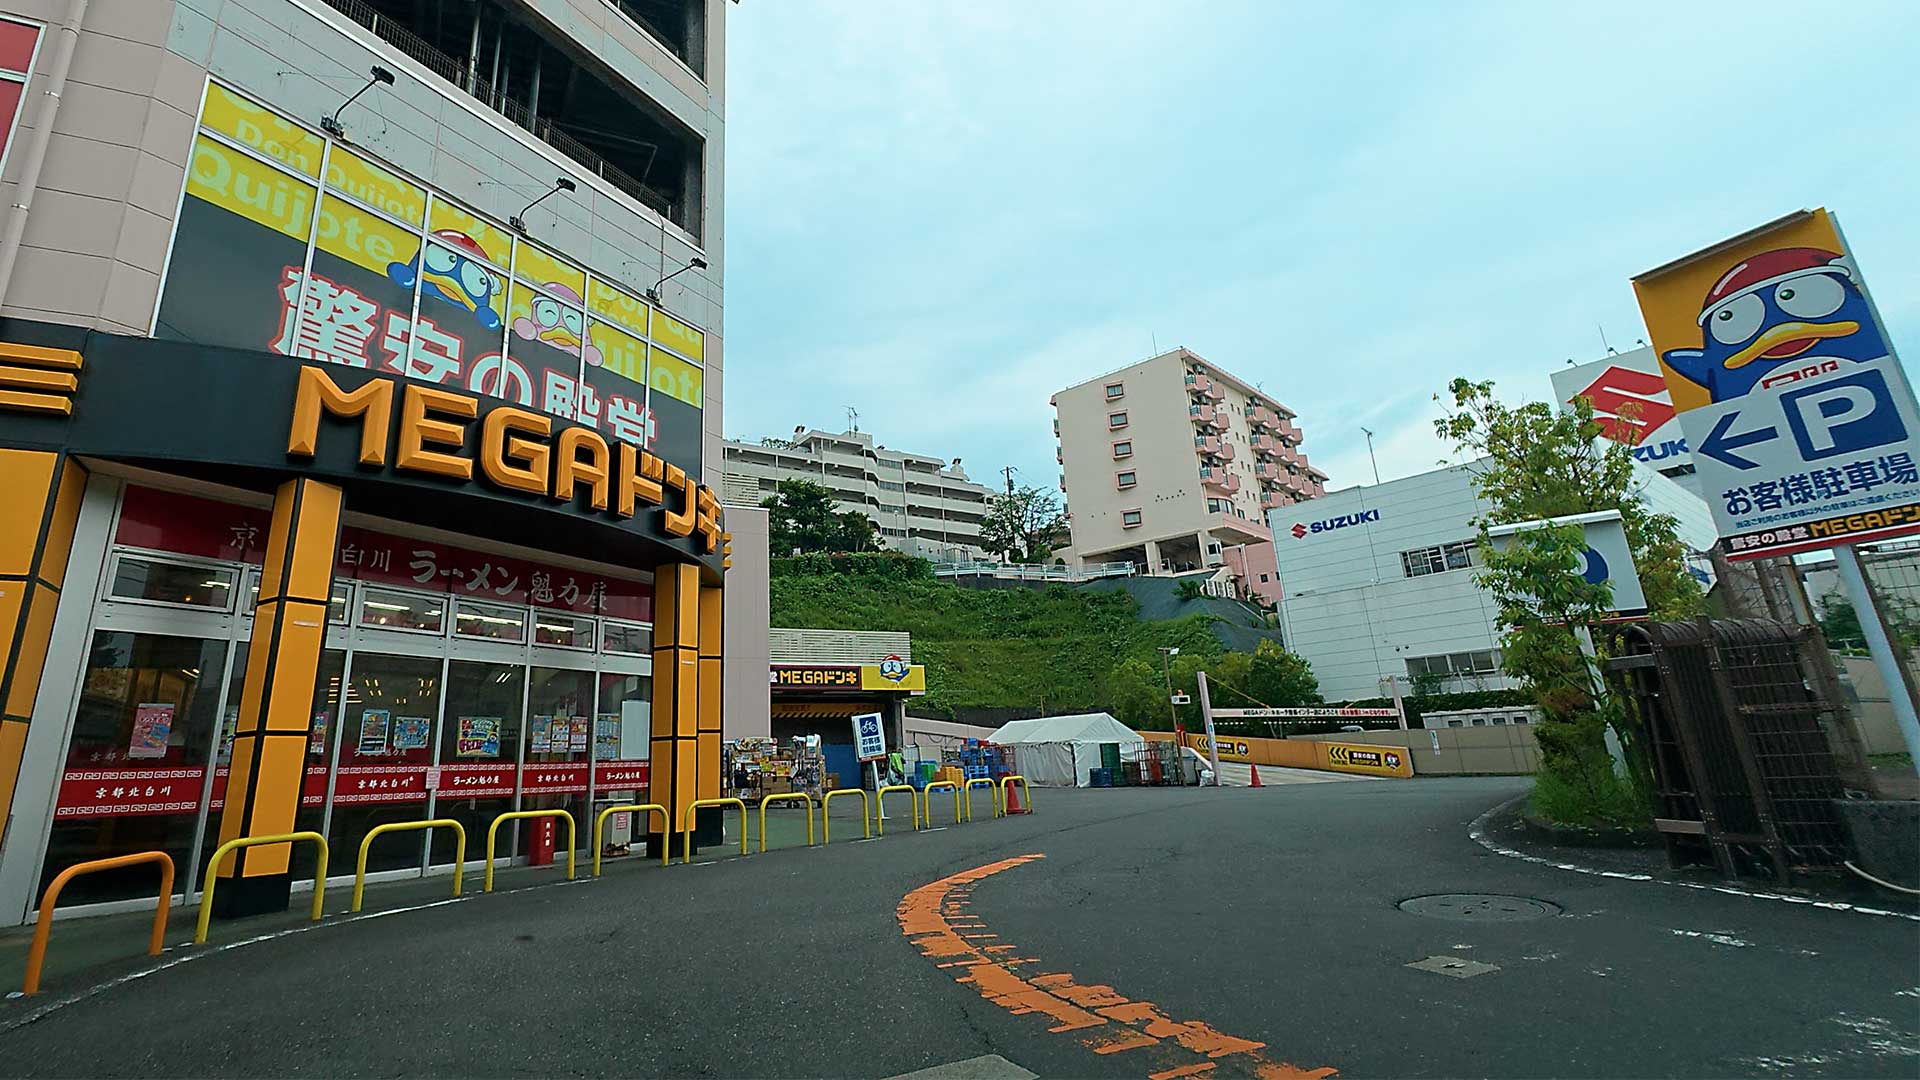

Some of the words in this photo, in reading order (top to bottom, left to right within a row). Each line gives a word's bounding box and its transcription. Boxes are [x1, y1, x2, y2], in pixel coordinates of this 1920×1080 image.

[191, 143, 394, 265] Quijote
[235, 118, 309, 176] Don
[326, 161, 436, 229] Quijot
[268, 265, 657, 451] 驚安の殿堂
[1632, 437, 1690, 463] ZUK
[1795, 385, 1877, 452] P
[287, 364, 723, 554] MEGAドンキ
[1722, 452, 1919, 516] お客様駐車場
[1310, 508, 1380, 534] SUZUKI
[1730, 526, 1809, 550] 驚安の殿堂
[779, 670, 858, 684] MEGAドンキ
[95, 785, 173, 799] 京都北白川
